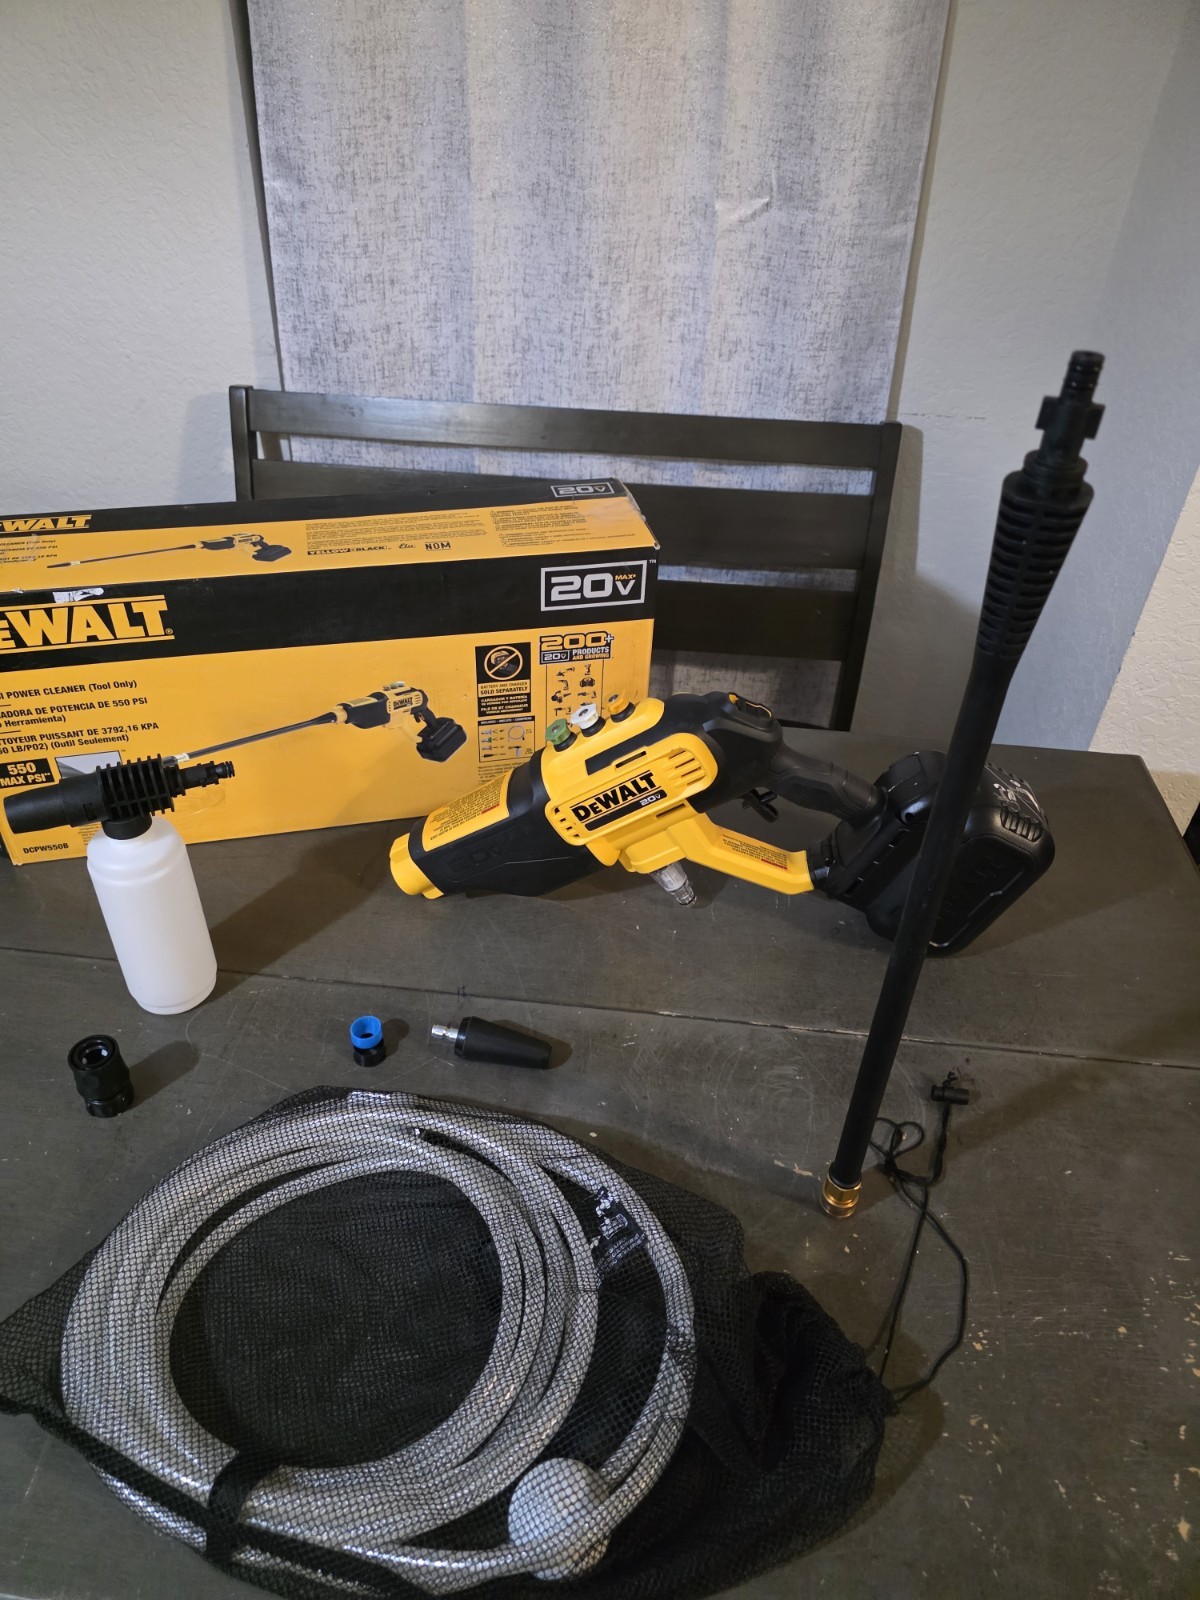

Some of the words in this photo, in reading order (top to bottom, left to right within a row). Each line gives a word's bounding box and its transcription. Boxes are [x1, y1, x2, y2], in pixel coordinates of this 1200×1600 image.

[0, 516, 92, 532] WALT
[425, 541, 451, 550] NOM
[551, 572, 635, 601] 20V
[572, 646, 610, 655] PRODUCTS
[6, 688, 41, 699] POWER
[43, 684, 86, 695] CLEANER
[89, 682, 111, 692] (Tool
[113, 680, 137, 689] Only)
[0, 709, 33, 718] ADORA
[35, 707, 48, 715] DE
[50, 702, 96, 713] POTENCIA
[97, 700, 111, 709] DE
[112, 699, 130, 707] 550
[132, 697, 148, 705] PSI
[4, 714, 66, 727] Herramienta)
[39, 729, 84, 741] PUISSANT
[86, 728, 99, 736] DE
[101, 724, 139, 734] 3792,16
[140, 722, 159, 731] KPA
[51, 739, 75, 750] (Outil
[77, 734, 129, 746] Seulement)
[7, 762, 37, 775] 550
[0, 776, 24, 787] MAX
[571, 771, 656, 821] DEWALT
[23, 842, 69, 854] DCPW550B
